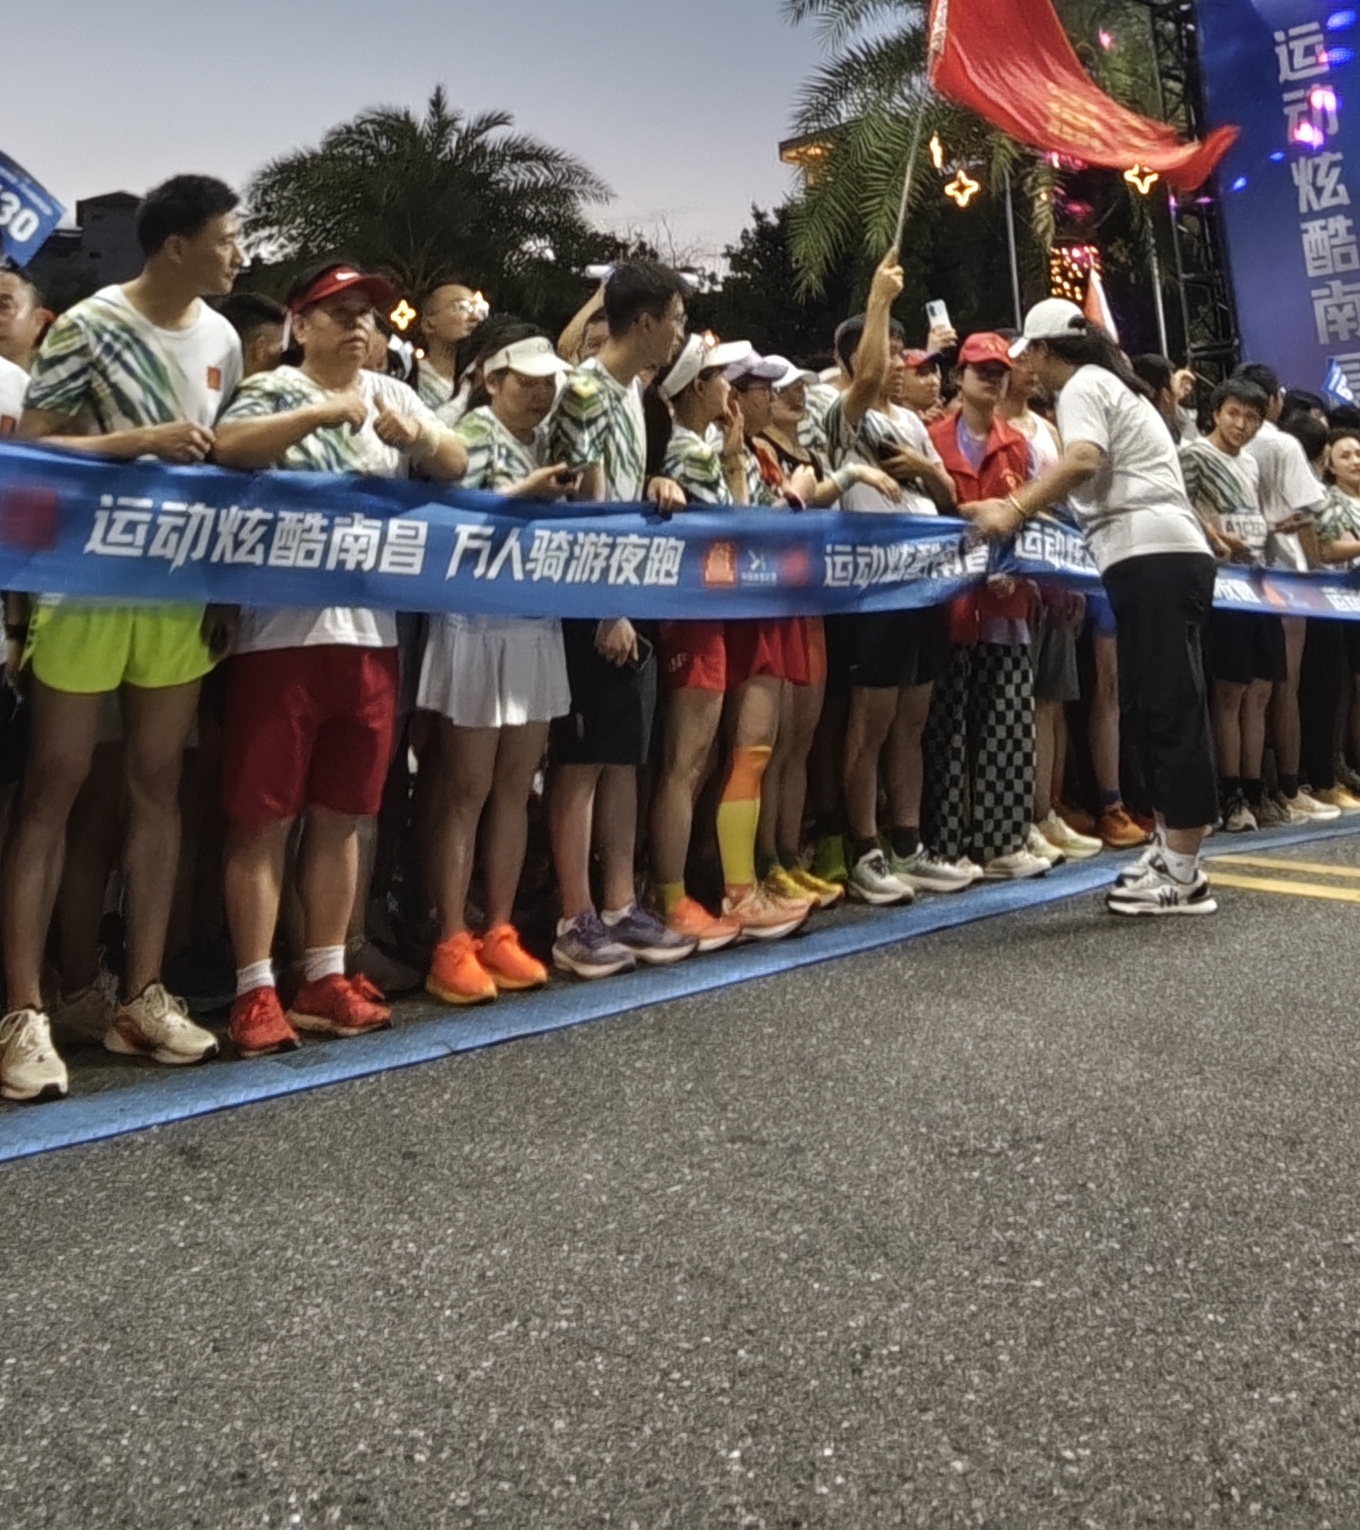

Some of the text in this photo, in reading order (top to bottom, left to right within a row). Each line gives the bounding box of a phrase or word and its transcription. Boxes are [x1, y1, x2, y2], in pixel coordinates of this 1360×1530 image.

[84, 495, 686, 587] 运动炫酷南昌 万人骑游夜跑
